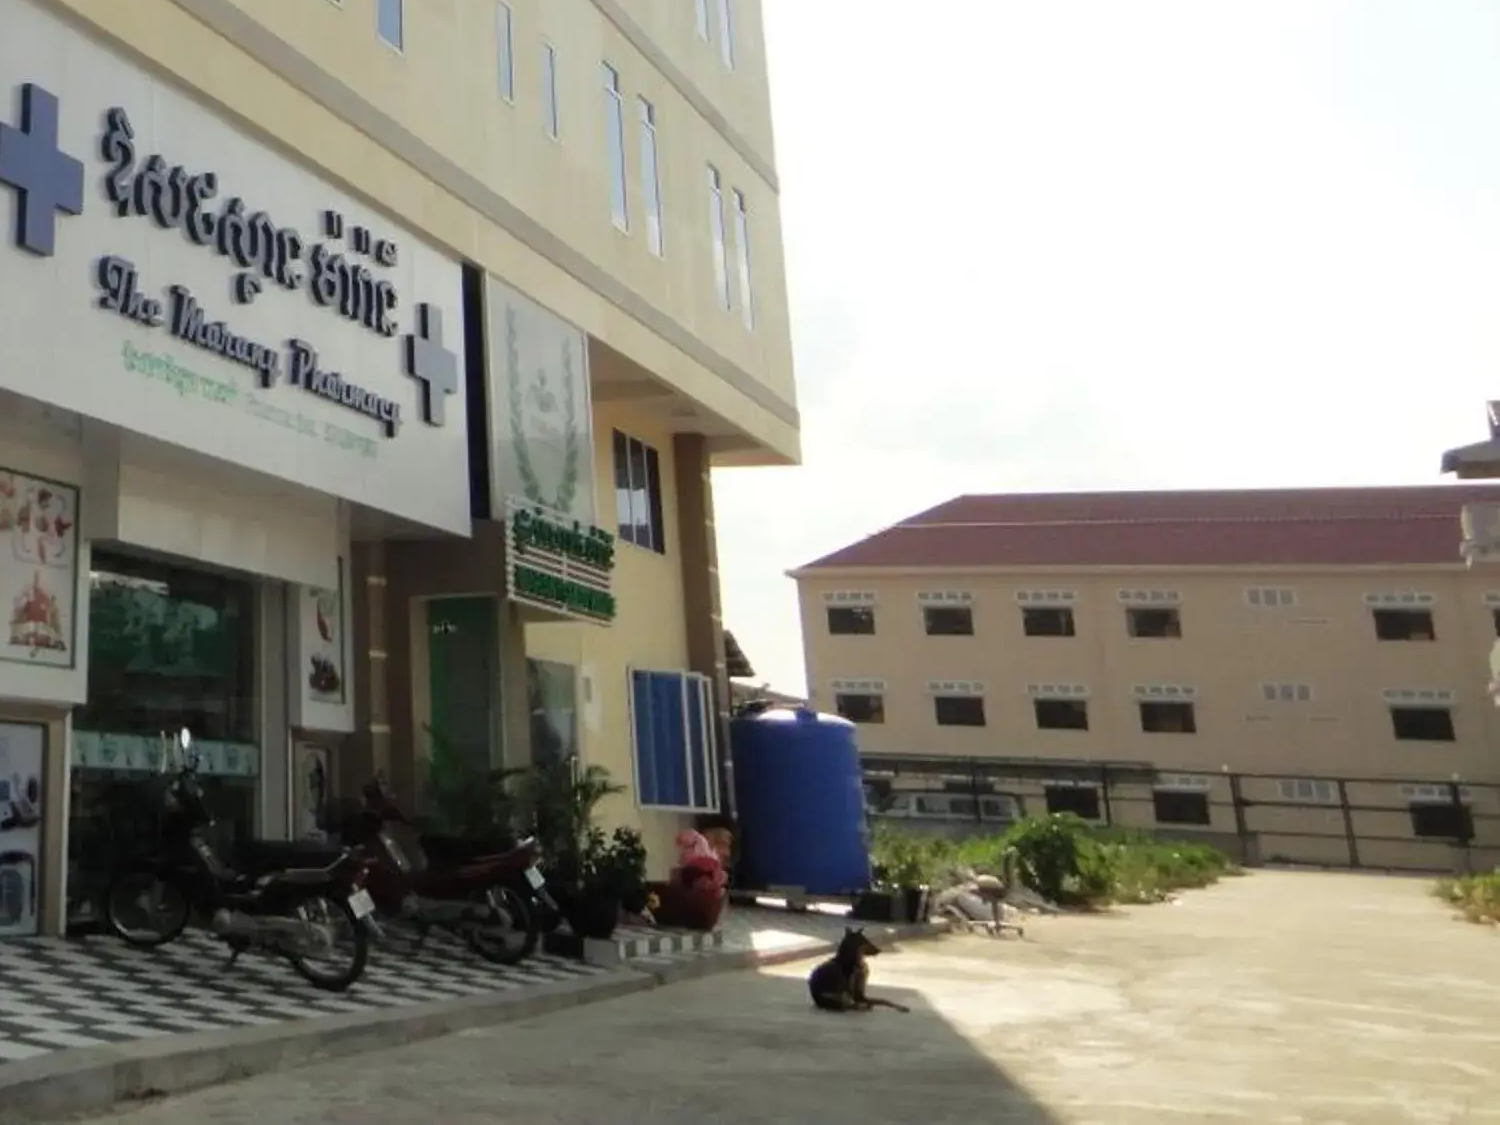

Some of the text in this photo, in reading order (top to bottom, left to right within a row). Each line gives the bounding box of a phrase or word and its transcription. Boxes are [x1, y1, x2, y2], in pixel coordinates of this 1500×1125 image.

[94, 255, 165, 327] The
[165, 283, 282, 389] Marany
[285, 337, 403, 439] Pharmacy
